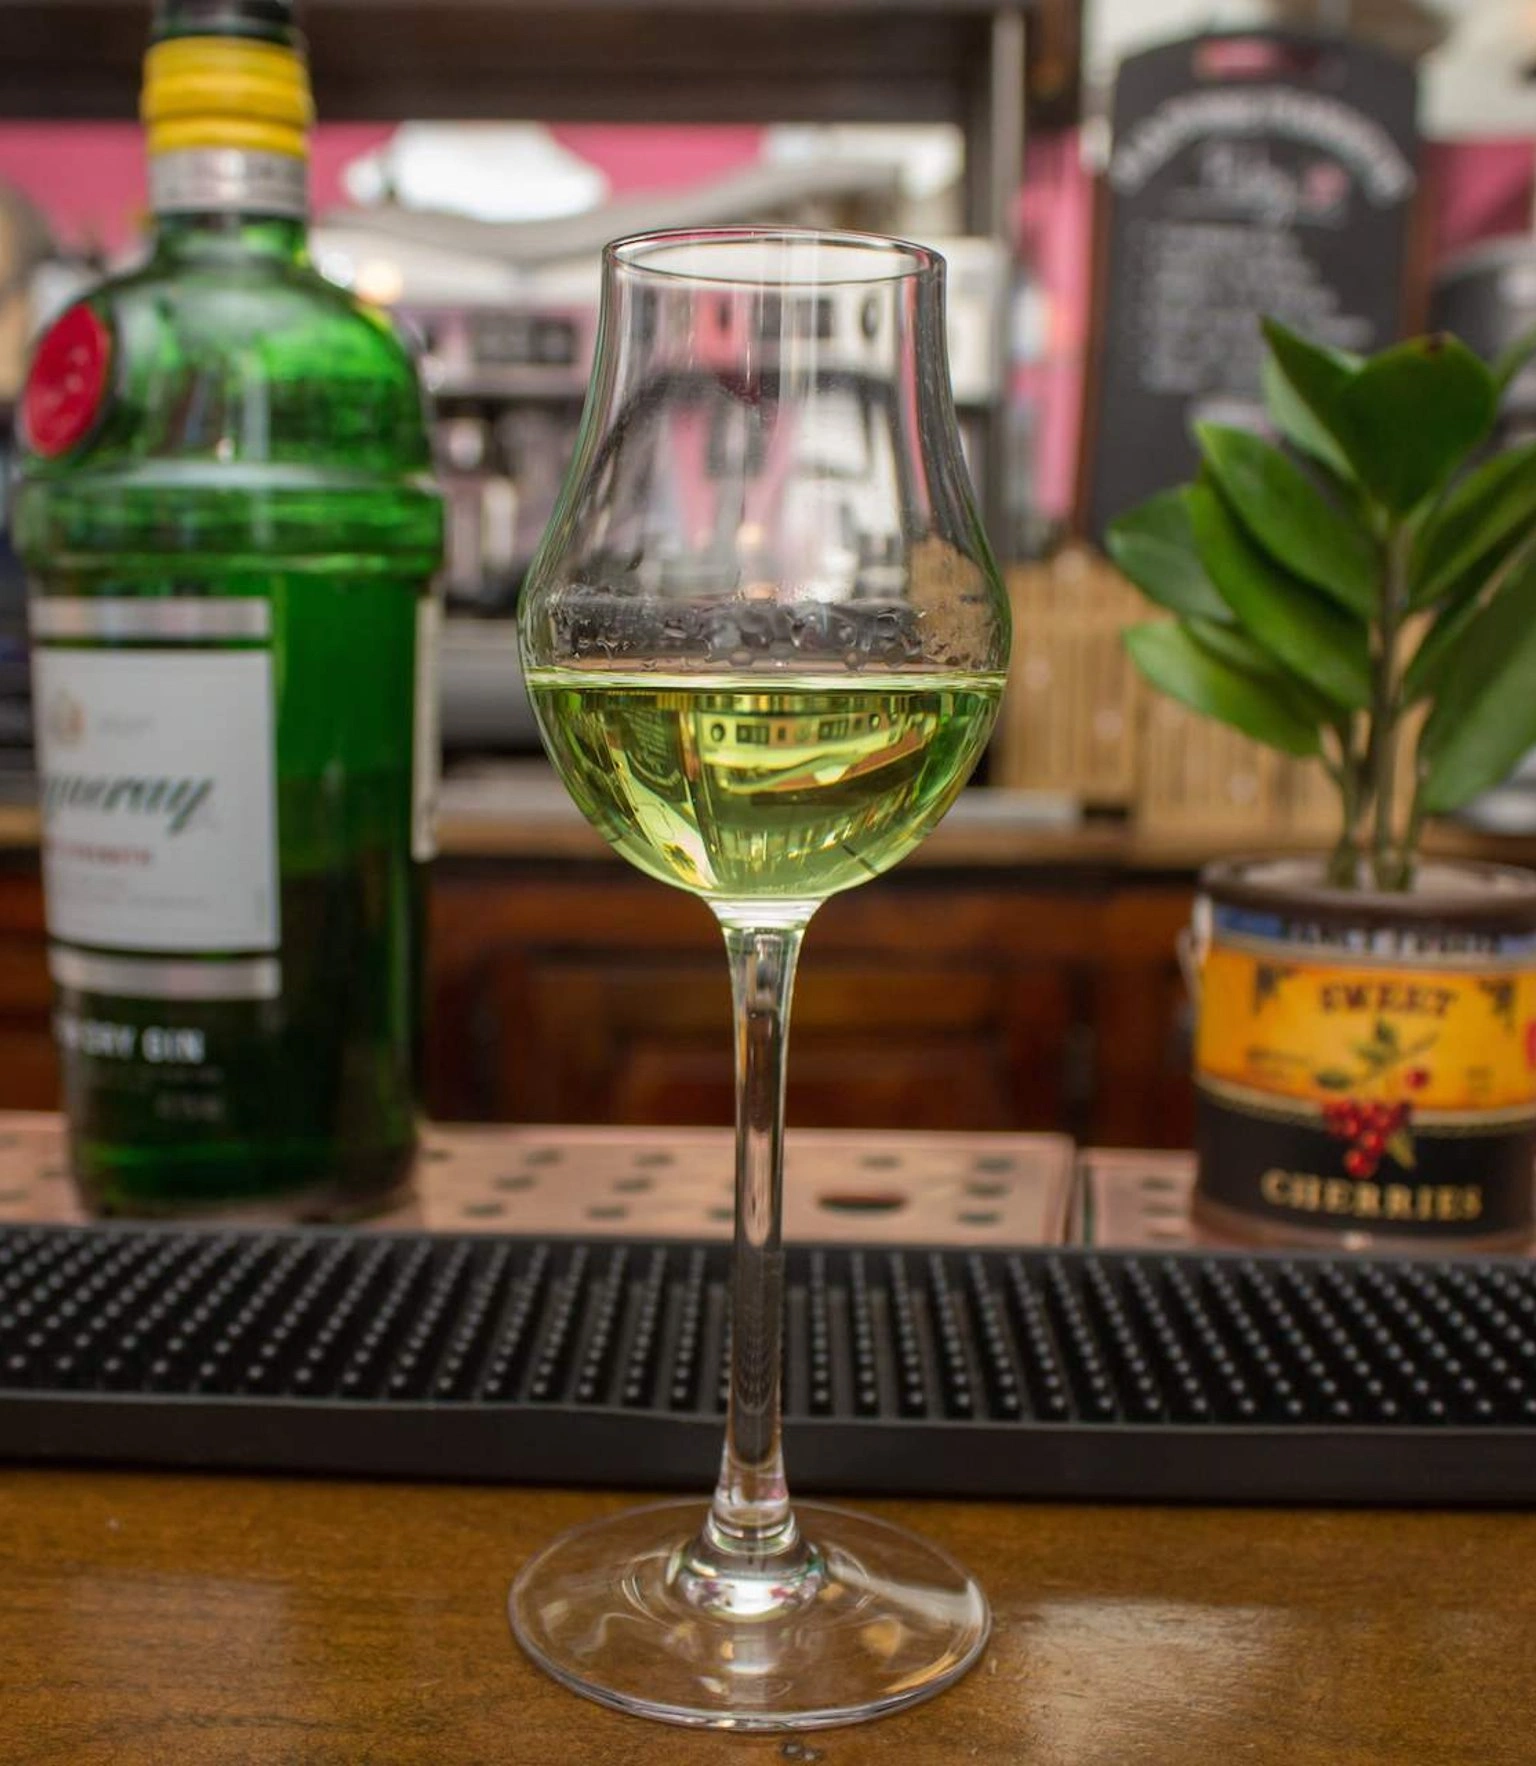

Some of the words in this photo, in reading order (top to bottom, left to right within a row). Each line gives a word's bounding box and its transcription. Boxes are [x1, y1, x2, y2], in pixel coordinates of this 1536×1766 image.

[1320, 982, 1458, 1018] SWEET
[141, 1025, 206, 1064] GIN
[1261, 1168, 1483, 1222] CHERRIES
